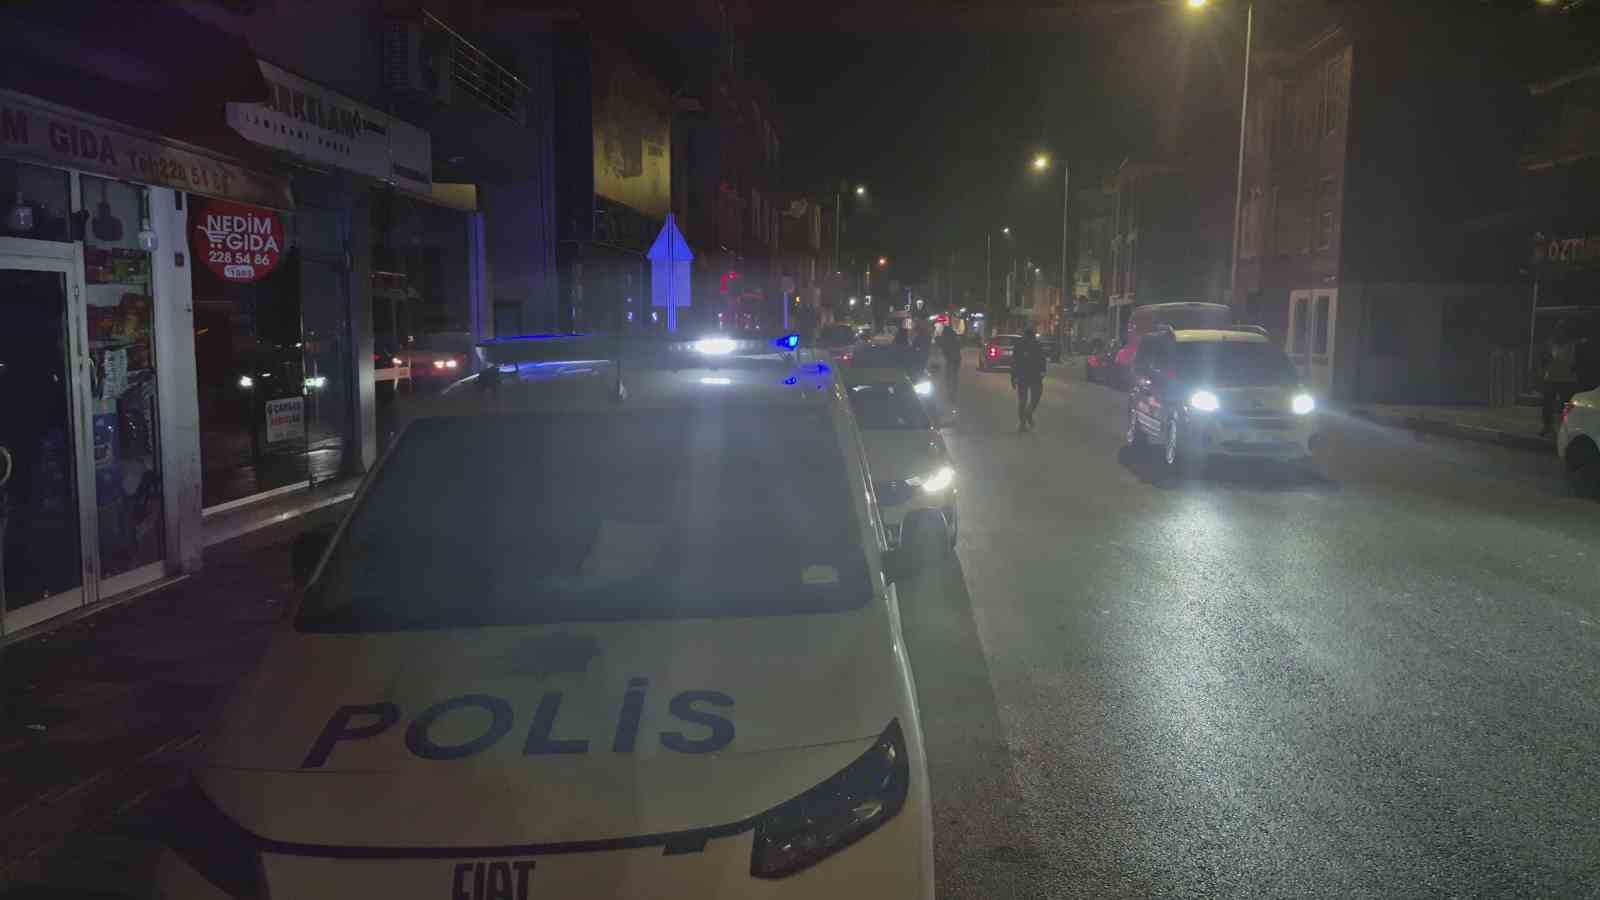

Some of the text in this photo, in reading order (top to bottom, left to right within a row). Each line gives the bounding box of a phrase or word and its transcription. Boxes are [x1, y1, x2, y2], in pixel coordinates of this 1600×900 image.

[48, 120, 118, 166] GIDA
[207, 212, 272, 235] NEDİM
[208, 250, 270, 265] 228 54 86
[225, 233, 280, 254] GIDA
[301, 677, 736, 769] POLİS
[451, 861, 537, 900] FIAT
